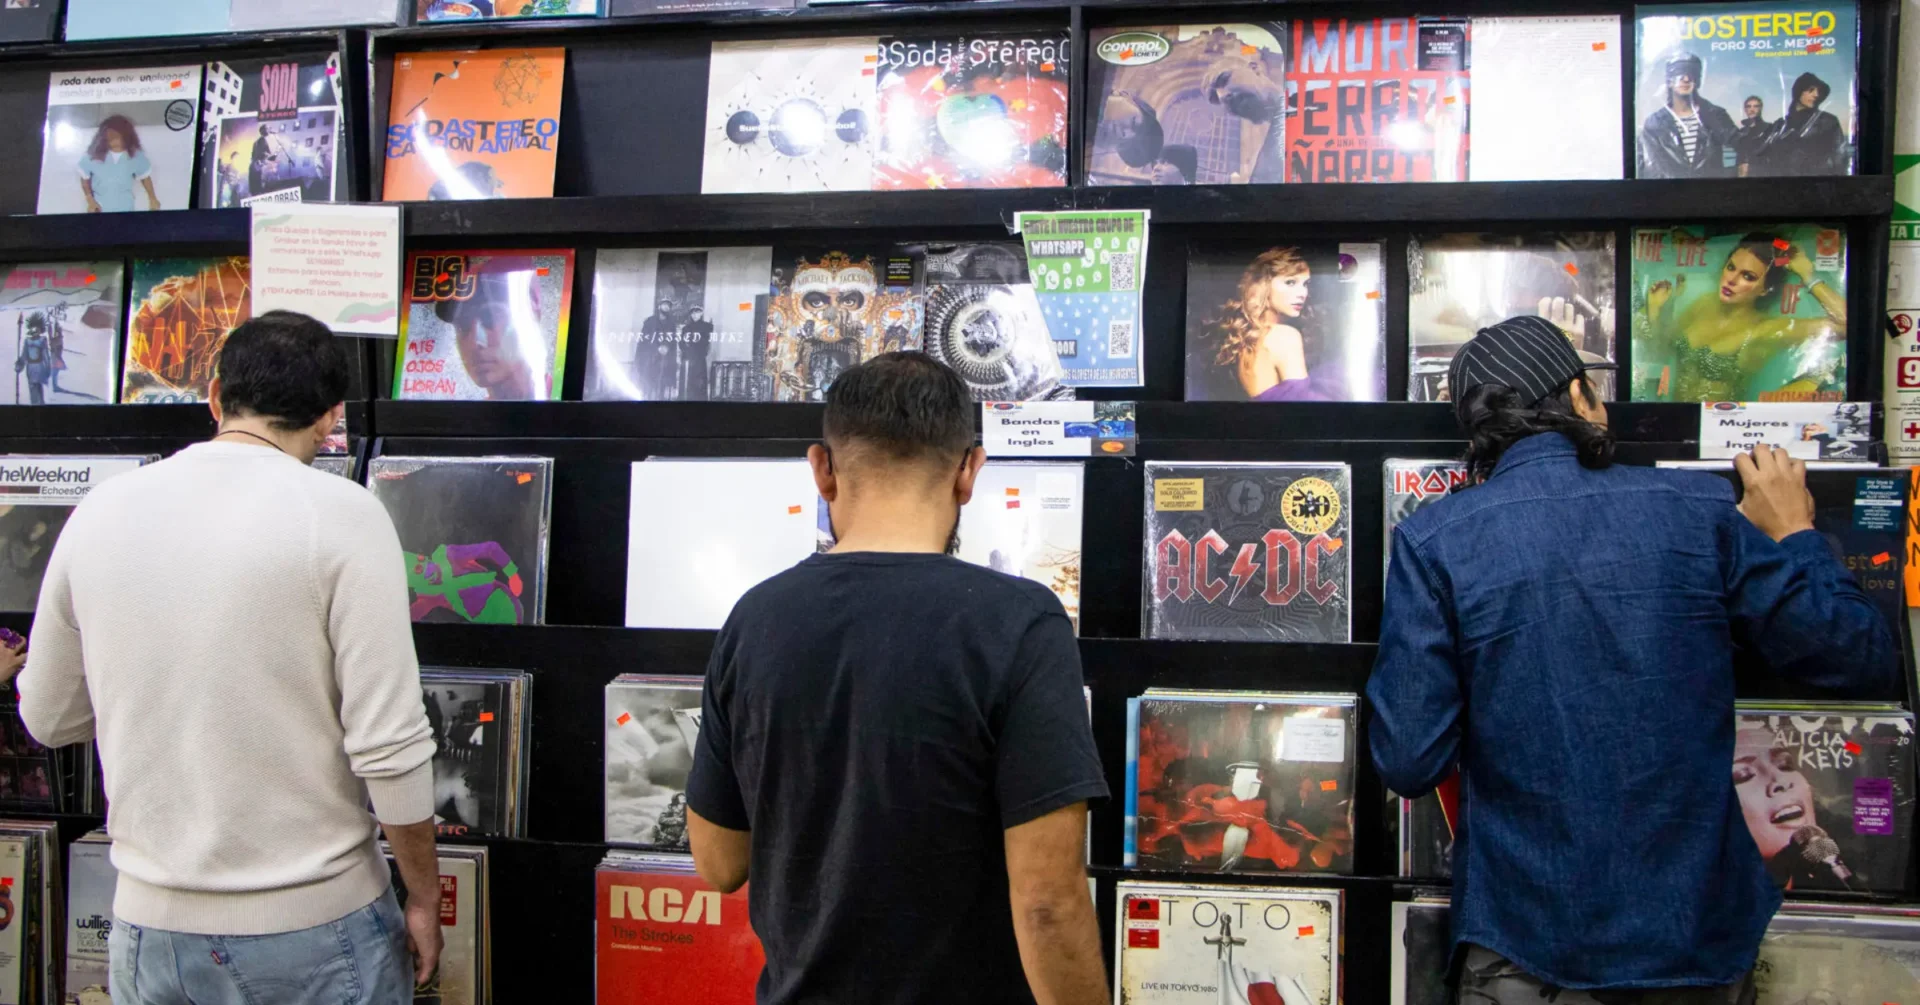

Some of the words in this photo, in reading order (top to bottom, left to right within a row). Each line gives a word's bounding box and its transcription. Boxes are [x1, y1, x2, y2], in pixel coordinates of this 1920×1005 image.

[1102, 41, 1162, 53] CONTROL
[1711, 41, 1746, 51] FORO
[1750, 40, 1774, 50] SOL
[59, 78, 82, 86] soda
[83, 76, 111, 85] stereo
[117, 74, 134, 82] mtv
[260, 63, 298, 112] SODA
[1031, 240, 1085, 255] WHATSAPP
[1637, 232, 1665, 262] THE
[1676, 237, 1708, 266] LIFE
[413, 256, 467, 278] BIG
[411, 273, 478, 301] BOY
[1780, 284, 1803, 314] OF
[408, 339, 436, 355] MIS
[406, 359, 446, 373] OJOS
[1657, 365, 1671, 396] A
[1719, 419, 1789, 428] Mujeres
[1007, 438, 1054, 447] Ingles
[1725, 440, 1780, 450] Ings
[0, 466, 91, 483] heWeeknd
[1394, 469, 1467, 501] IRON
[1862, 576, 1896, 590] love
[1773, 730, 1846, 747] ALICIA
[1798, 748, 1854, 770] KEYS
[609, 885, 722, 926] RCA
[1162, 900, 1290, 930] TOTO
[611, 925, 637, 941] The
[639, 926, 694, 945] Strokes
[1141, 982, 1159, 990] LIVE
[1160, 983, 1169, 991] IN
[1171, 983, 1199, 992] TOKYO
